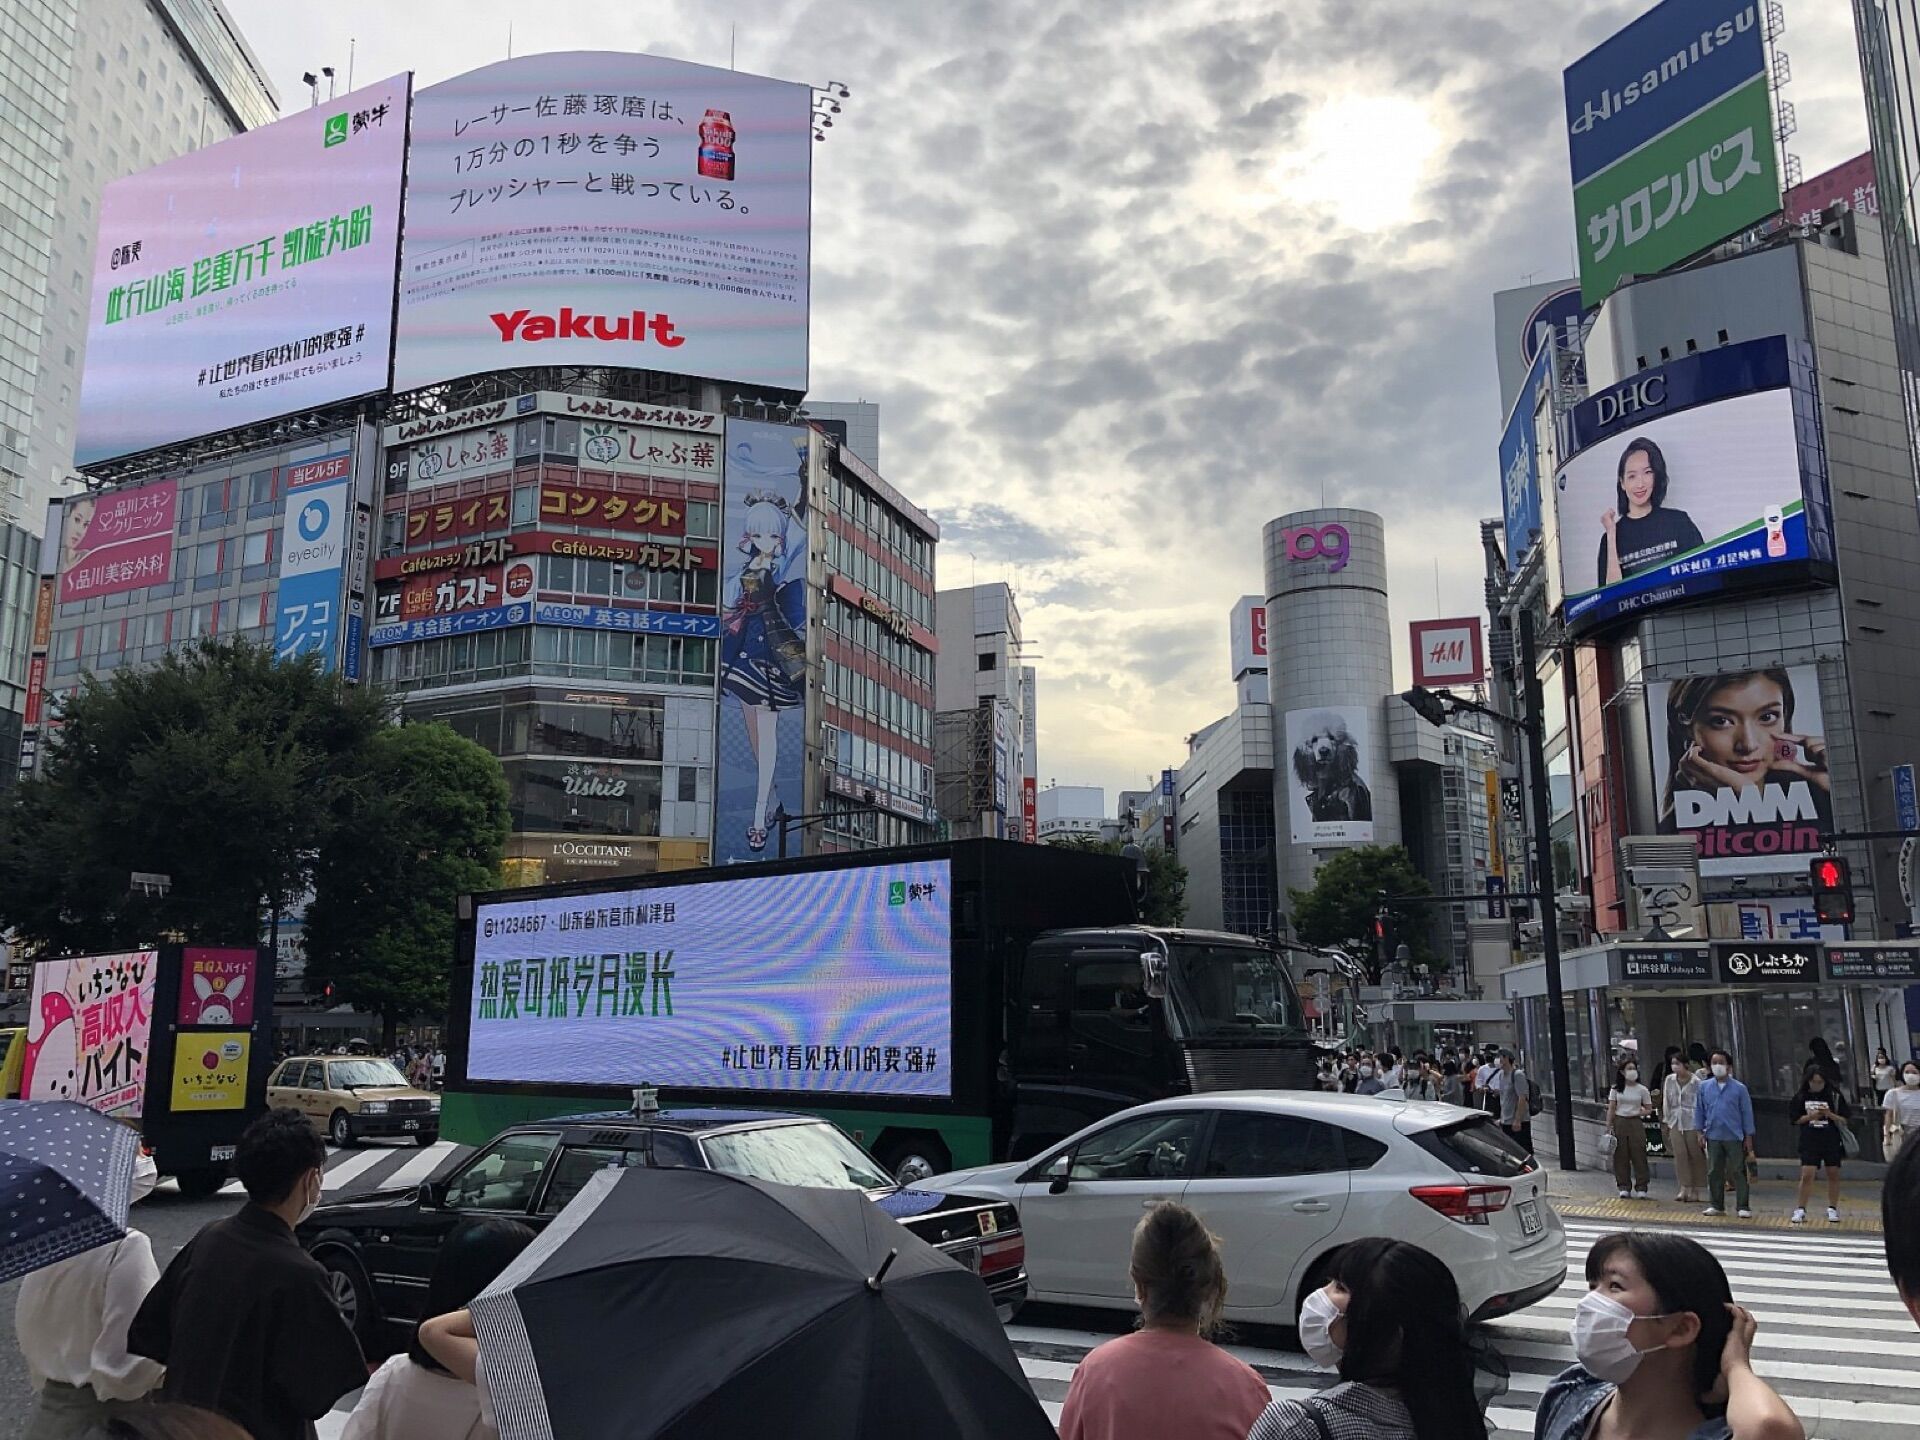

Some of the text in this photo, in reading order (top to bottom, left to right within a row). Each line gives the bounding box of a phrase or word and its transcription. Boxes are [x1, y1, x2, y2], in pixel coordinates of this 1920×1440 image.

[1570, 4, 1755, 135] Hisamitsu
[454, 93, 685, 137] レーサー佐藤琢磨は、
[454, 133, 662, 174] 1万分の1秒を争う
[450, 172, 750, 215] プレッシャーと戦っている。
[1587, 126, 1762, 263] サロンパス
[105, 204, 372, 325] 此行山海 珍重万千 凯旋为盼
[490, 308, 686, 349] Yakult
[566, 396, 716, 429] しゃぶしゃぶバイキング
[1595, 374, 1668, 427] DHC
[399, 401, 508, 440] しゃぶしゃぶバイキング
[445, 432, 509, 469] しゃぶ葉
[628, 435, 716, 469] しゃぶ葉
[293, 462, 343, 486] 当ビル5F
[389, 461, 408, 479] 9F
[113, 490, 172, 518] 品川スキン
[408, 496, 508, 538] プライス
[541, 489, 681, 528] コンタクト
[112, 511, 164, 536] クリニック
[287, 542, 336, 567] eyecity
[463, 538, 515, 568] ガスト
[638, 544, 703, 571] ガスト
[1281, 523, 1350, 573] 109
[75, 552, 165, 590] 品川美容外科
[379, 594, 400, 614] 7F
[433, 576, 497, 614] ガスト
[1618, 595, 1641, 613] DHC
[1641, 584, 1685, 606] Channel
[411, 611, 502, 637] 英会話イーオン
[540, 606, 584, 621] AEON
[595, 611, 717, 638] 英会話イーオン
[374, 626, 402, 641] AEON
[1429, 640, 1464, 664] H&M
[1673, 780, 1819, 828] DMM
[553, 842, 632, 858] L'OCCITANE
[483, 913, 547, 938] @t1234567
[192, 960, 248, 974] 高収入バイト
[1753, 953, 1809, 967] しぶちか
[79, 954, 148, 1003] いちごなび
[479, 948, 675, 1019] 热爱可抵岁月漫长
[81, 986, 148, 1052] 高収入
[81, 1036, 143, 1097] バイト
[721, 1043, 937, 1074] #让世界看见我们的要强#
